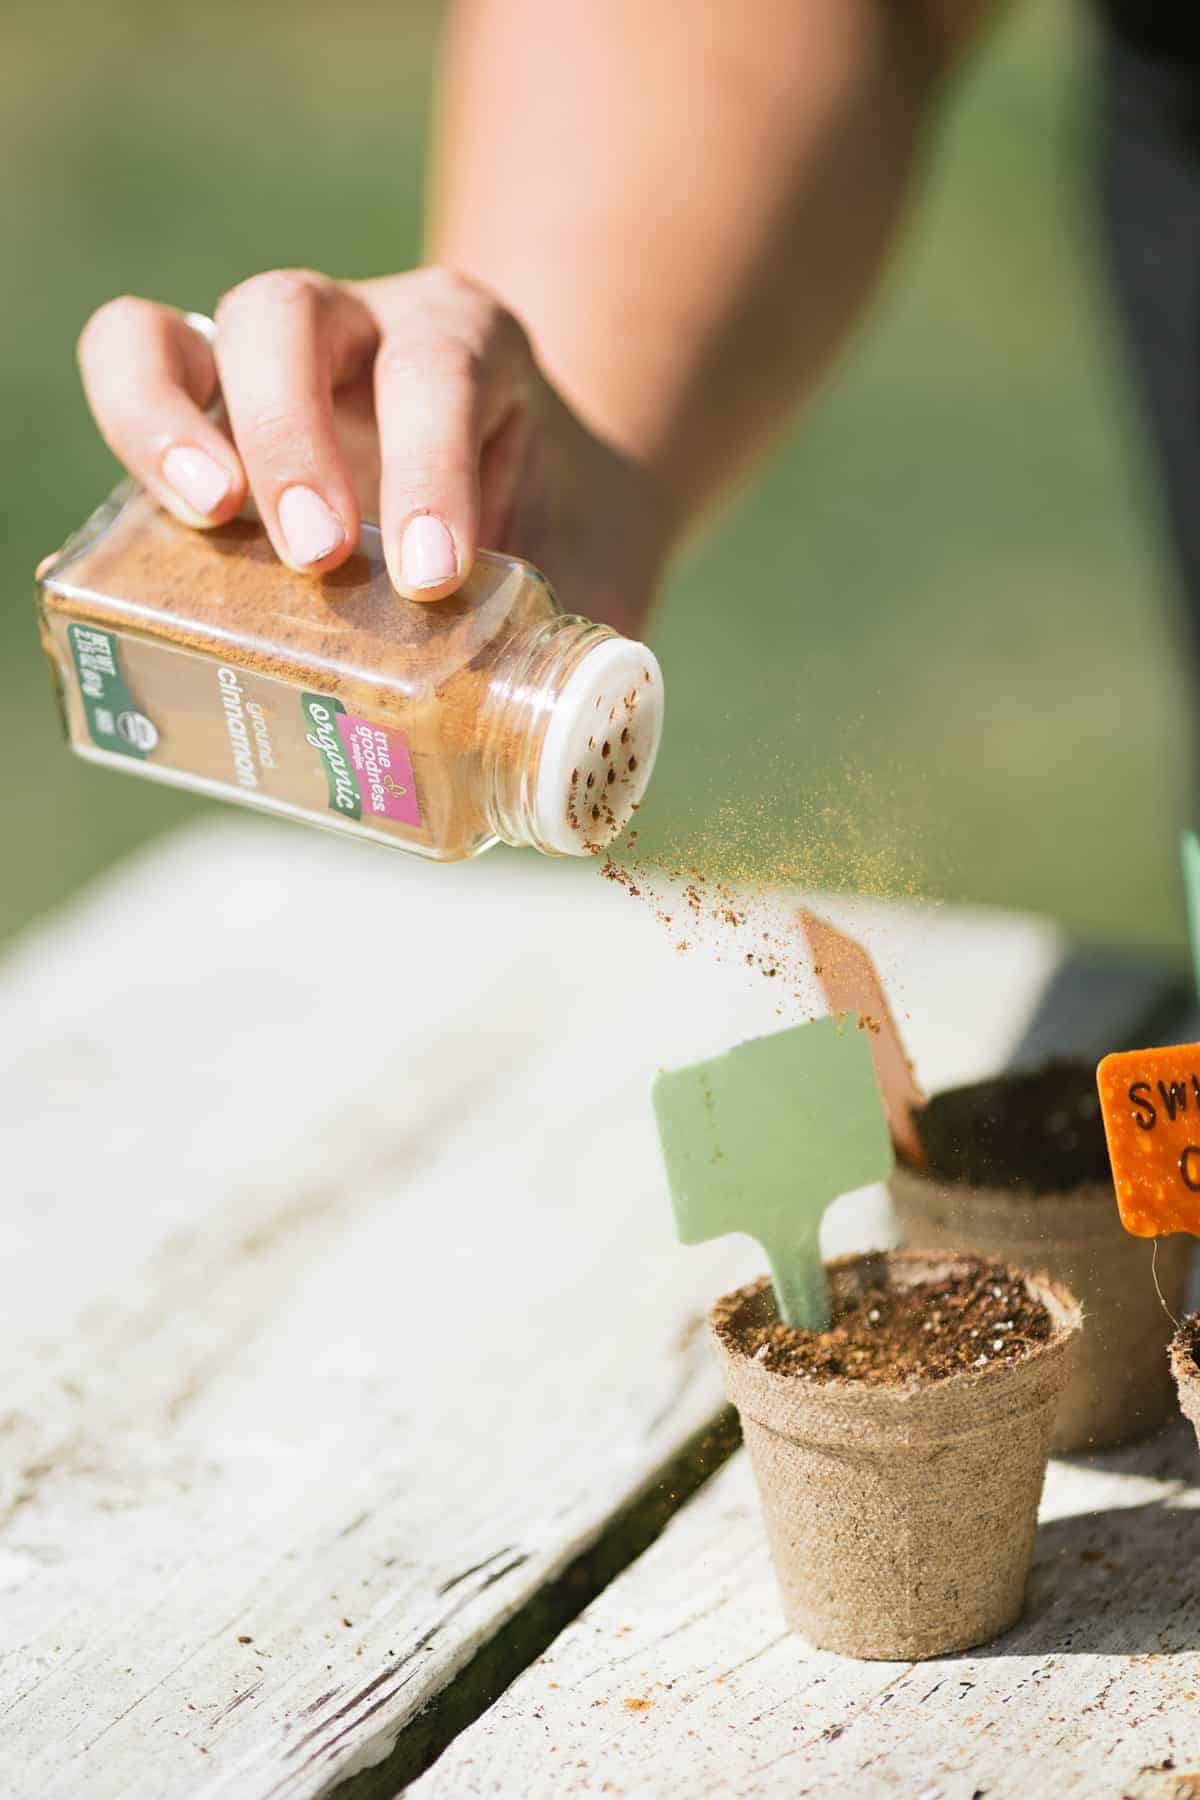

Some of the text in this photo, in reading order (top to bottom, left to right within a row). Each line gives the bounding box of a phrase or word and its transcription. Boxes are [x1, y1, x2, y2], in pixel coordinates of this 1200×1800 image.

[216, 667, 257, 788] cinnamon
[246, 701, 279, 768] ground
[306, 703, 361, 810] organic
[354, 725, 387, 812] goodness
[374, 731, 392, 768] true
